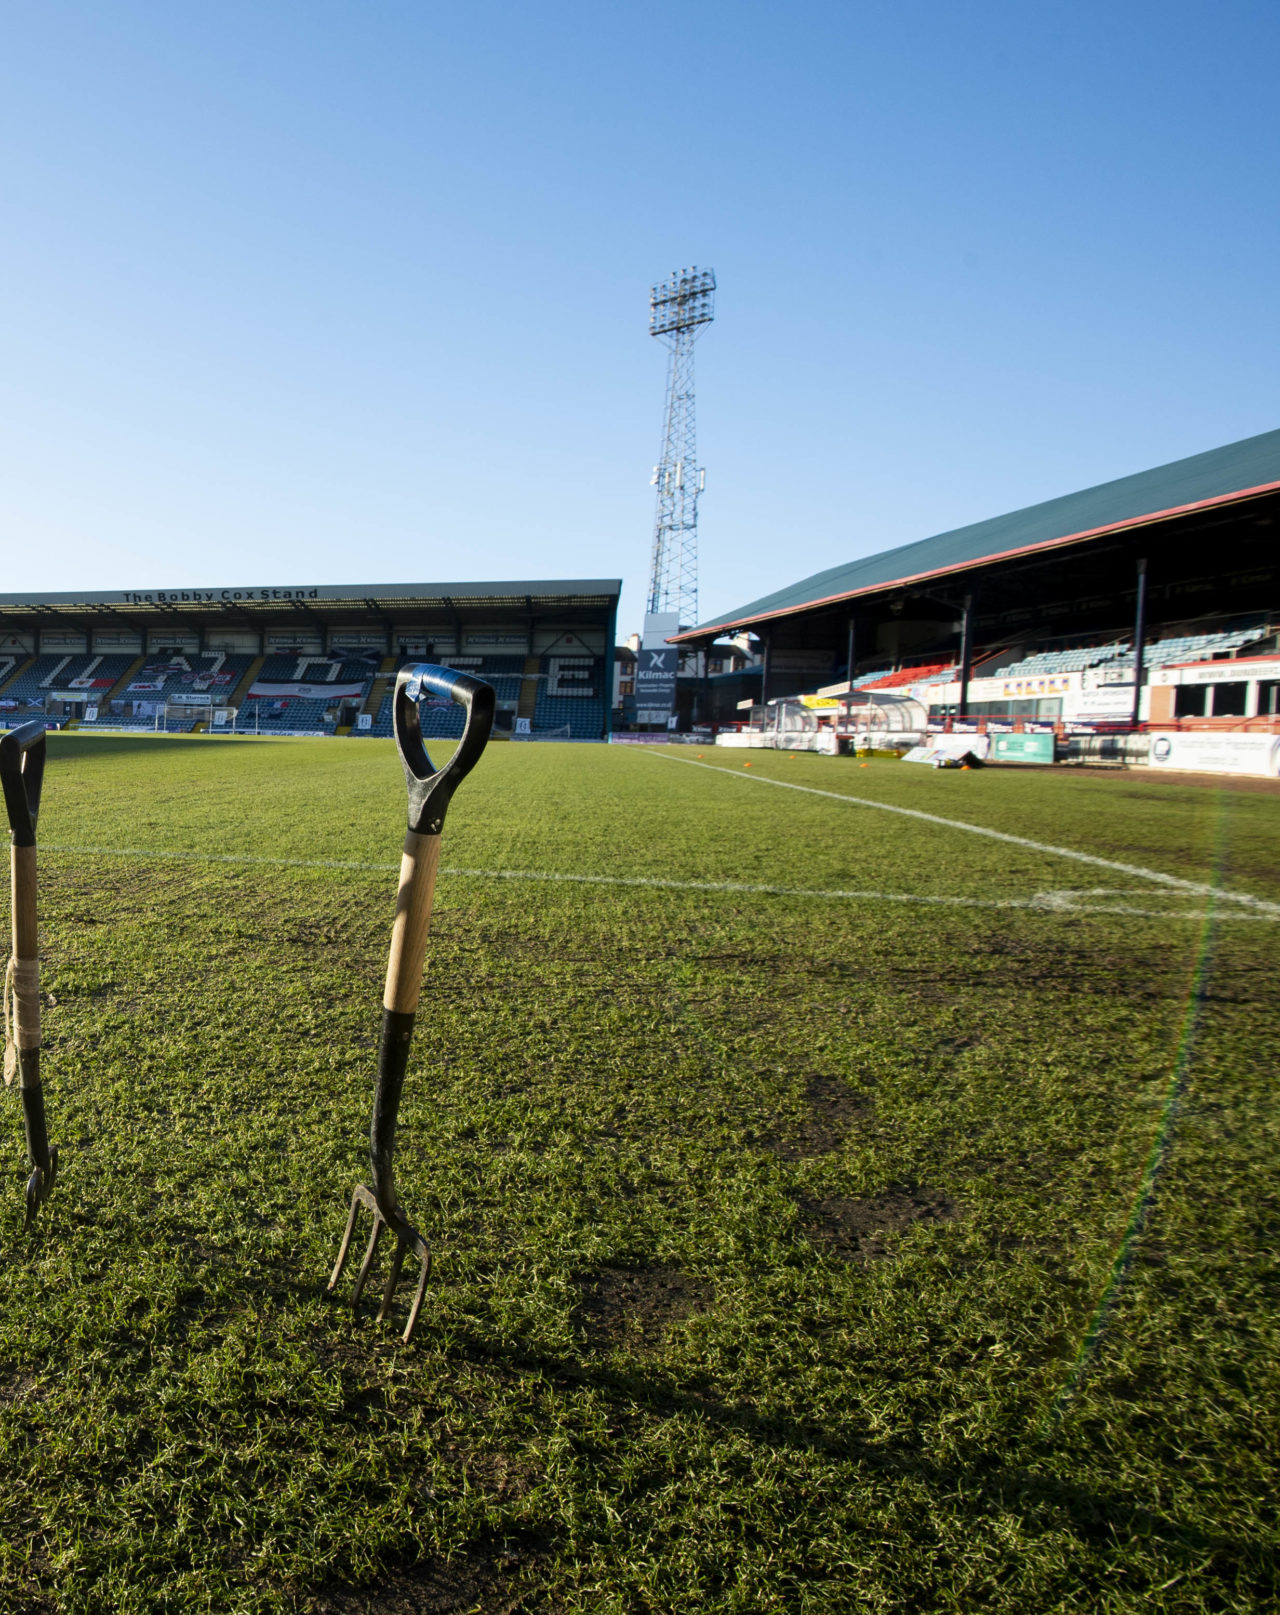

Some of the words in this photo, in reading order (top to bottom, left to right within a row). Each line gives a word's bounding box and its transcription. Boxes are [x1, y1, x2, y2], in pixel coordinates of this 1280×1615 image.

[123, 593, 153, 602] The
[158, 591, 213, 602] Bobby
[221, 590, 254, 600] Cox
[261, 588, 318, 599] Stand
[638, 670, 675, 679] Kilmac
